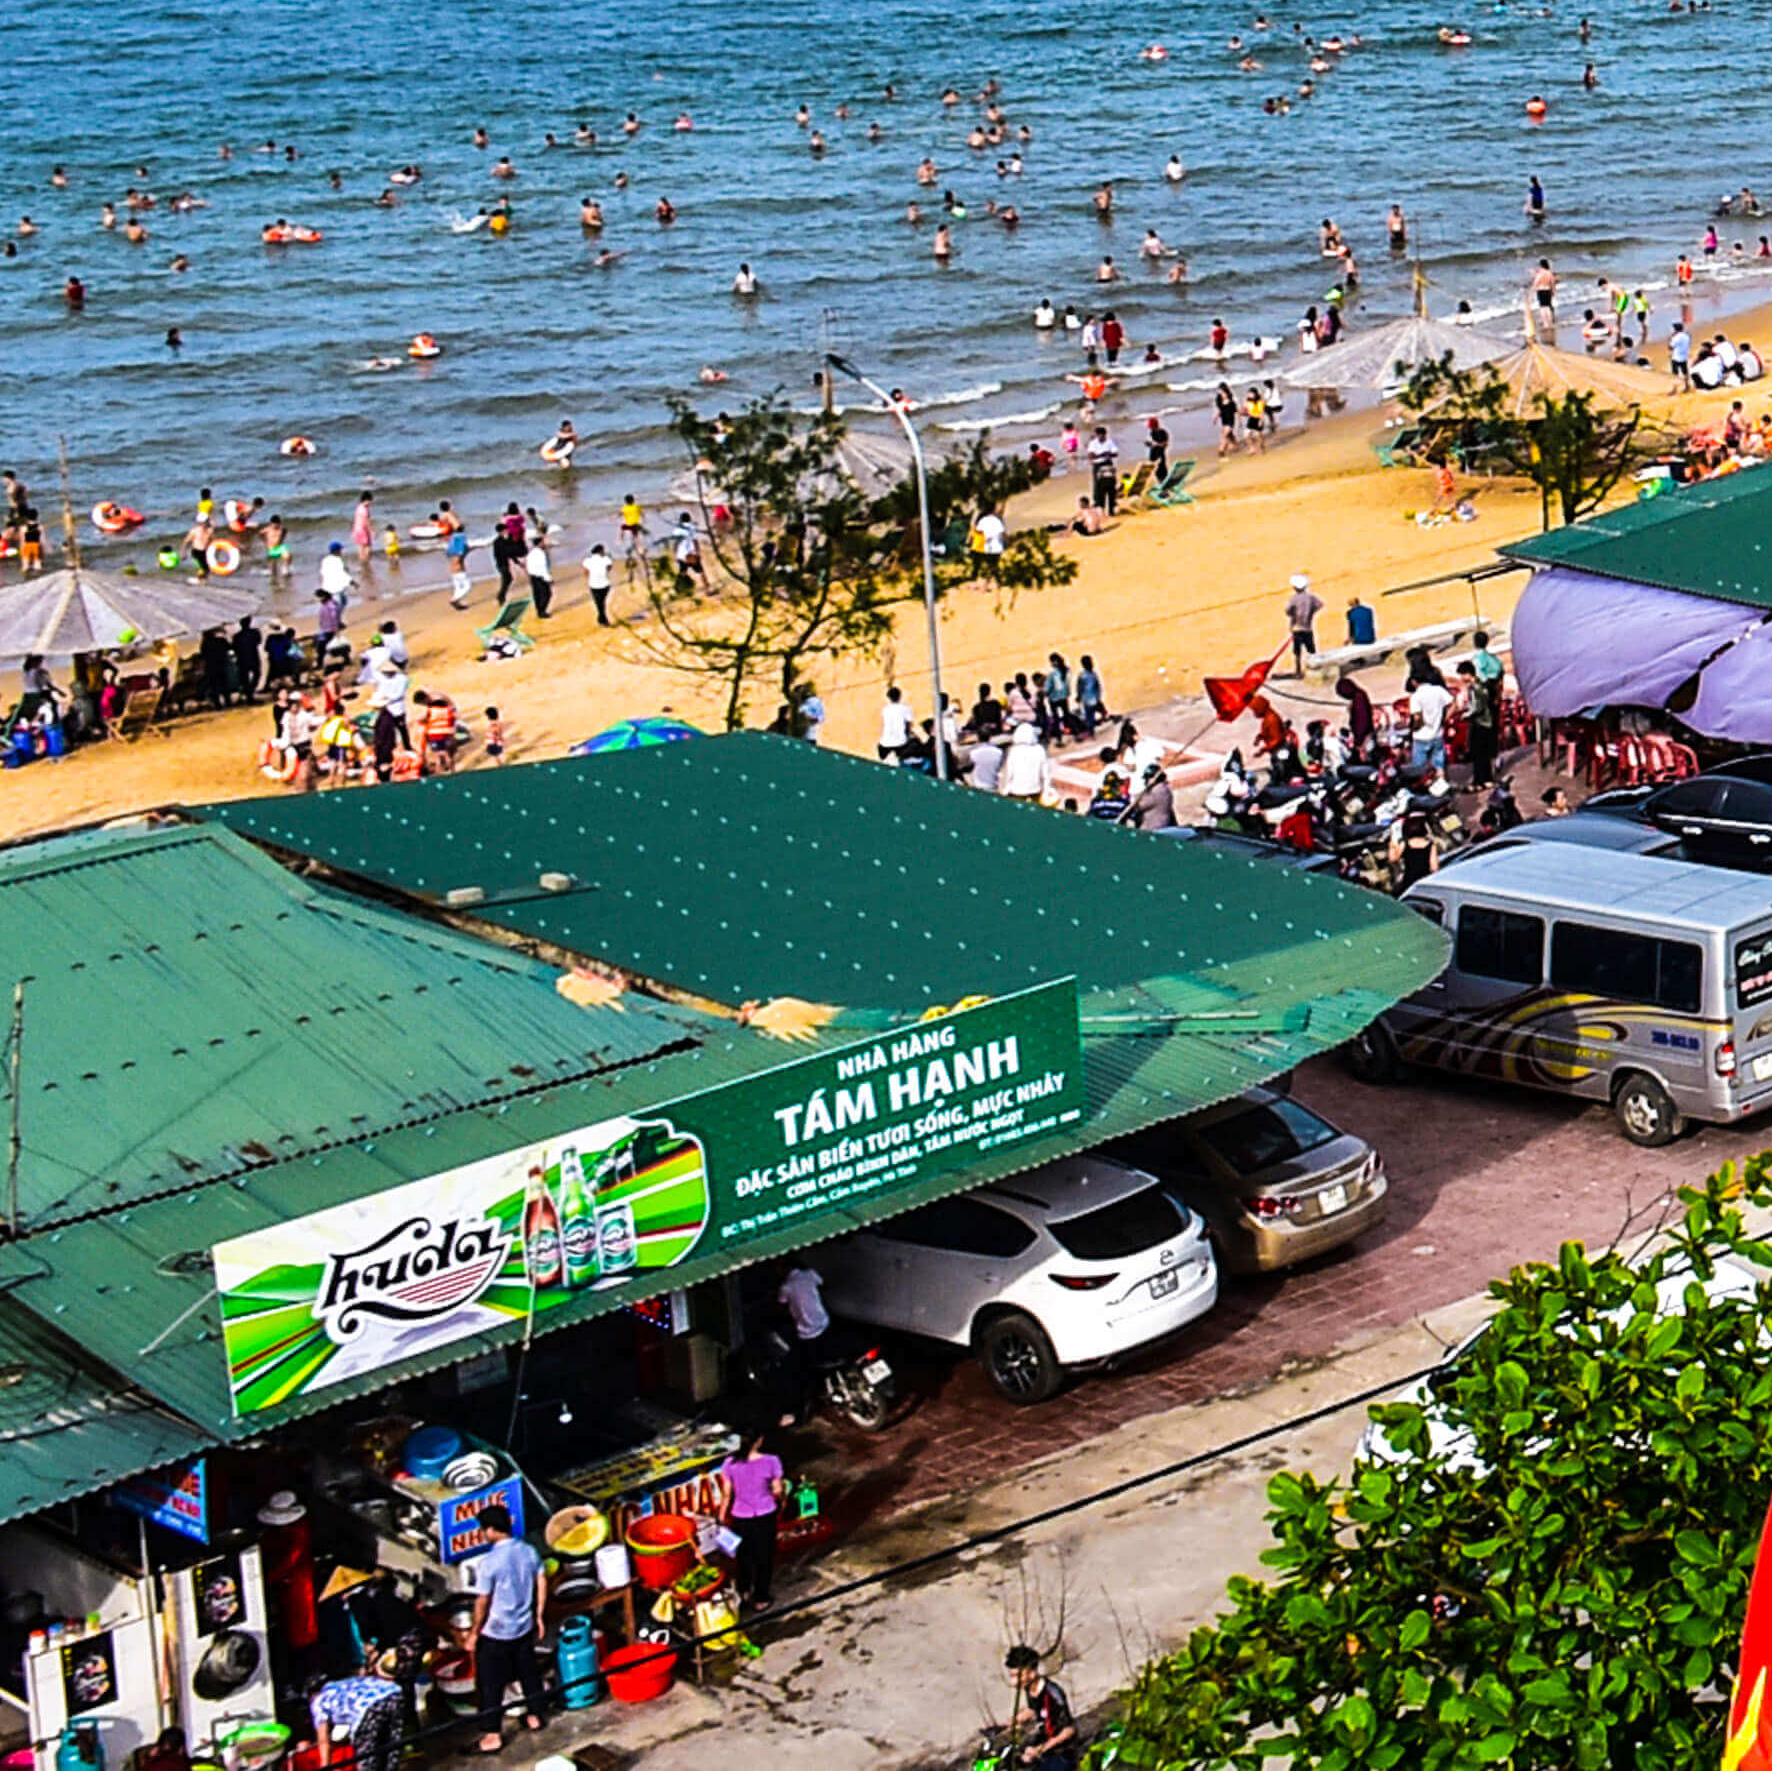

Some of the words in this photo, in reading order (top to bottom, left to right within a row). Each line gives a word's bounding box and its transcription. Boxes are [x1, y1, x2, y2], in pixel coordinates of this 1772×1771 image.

[774, 1081, 877, 1146] TÁM
[888, 1035, 1020, 1112] HẠNH
[837, 1043, 888, 1081] NHÀ
[891, 1025, 956, 1064] HÀNG
[734, 1167, 774, 1198] ĐẶC
[776, 1155, 816, 1184] SẢN
[865, 1122, 911, 1153] TƯƠI
[972, 1089, 1015, 1119] MỰC
[320, 1218, 502, 1310] huda
